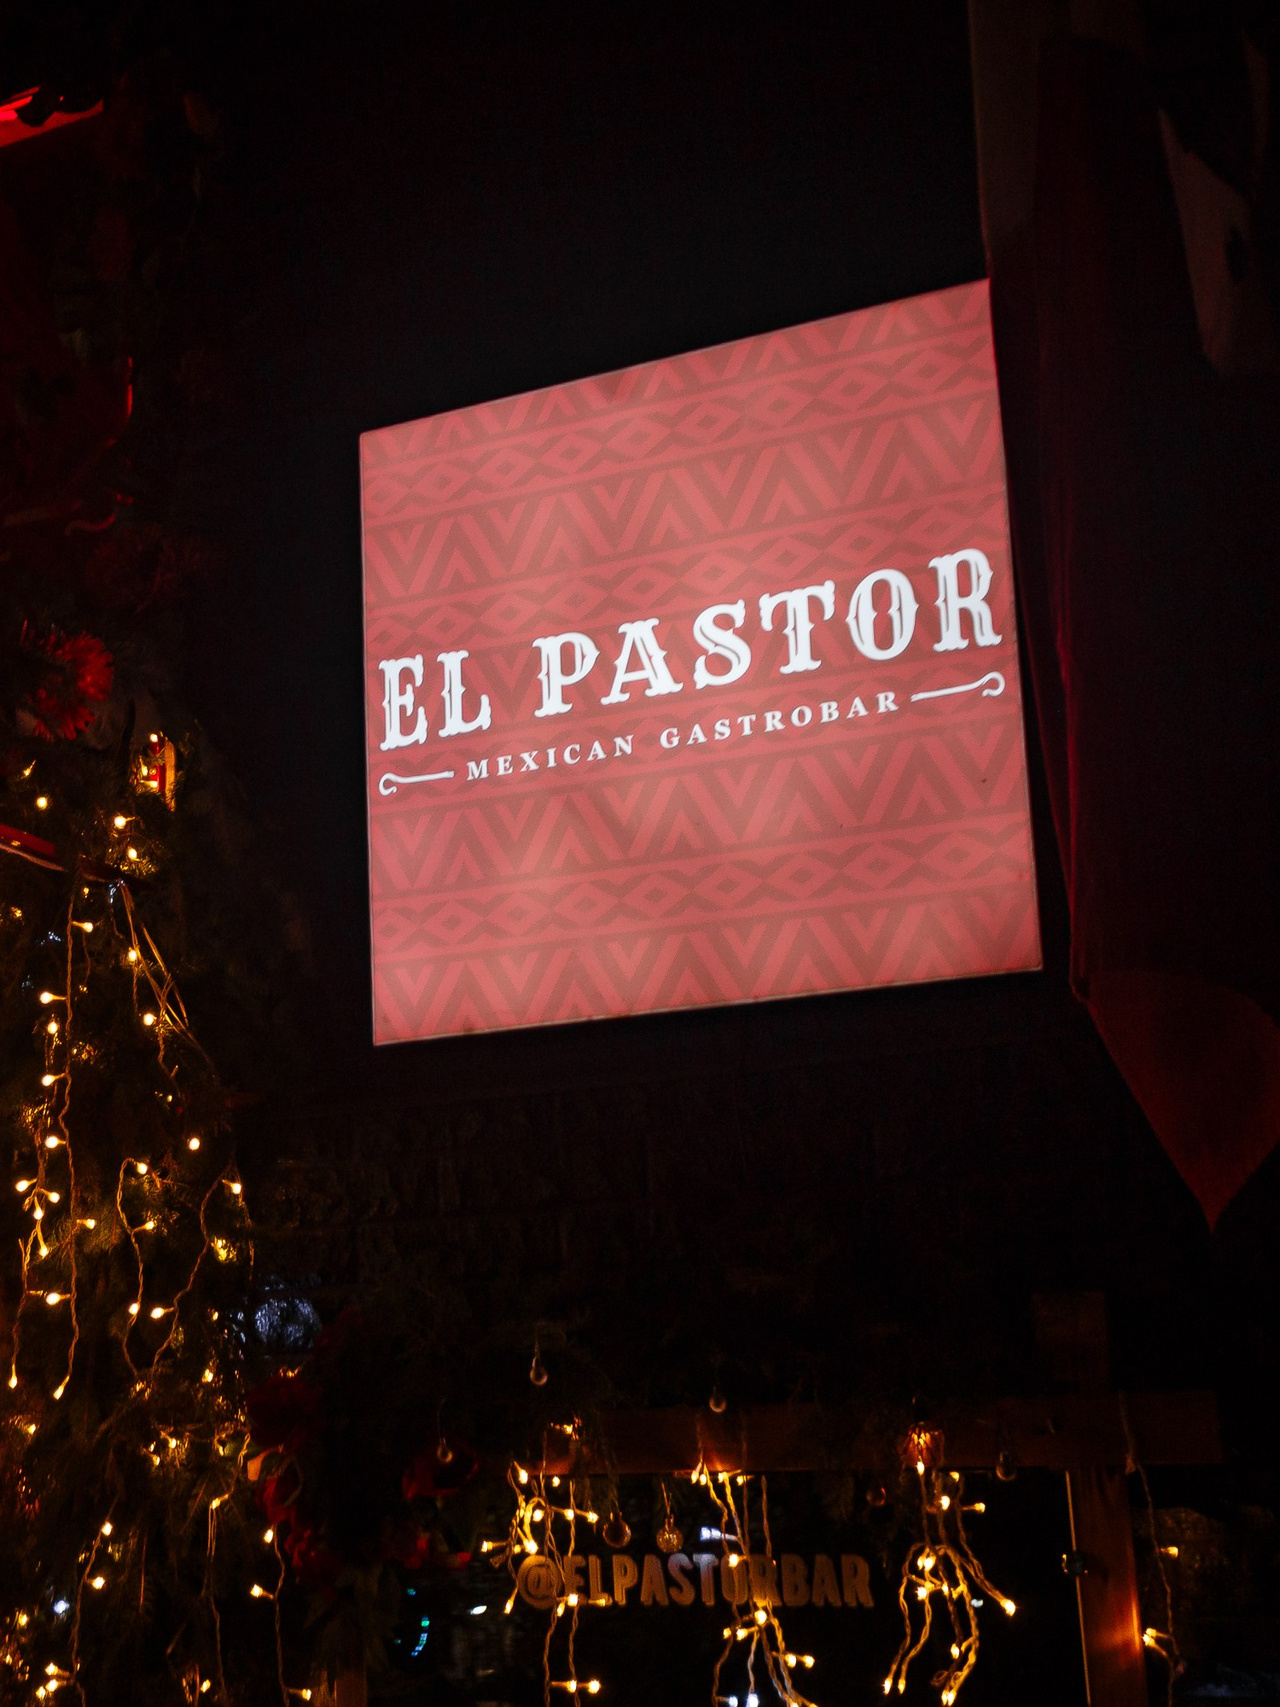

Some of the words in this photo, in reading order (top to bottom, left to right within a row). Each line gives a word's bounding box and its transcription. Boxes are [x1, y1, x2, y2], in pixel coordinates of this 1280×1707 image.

[379, 649, 491, 751] EL
[532, 547, 1003, 719] PASTOR
[466, 734, 635, 782] MEXICAN
[660, 690, 900, 750] GASTROBAR
[515, 1551, 876, 1611] @ELPASTORBAR
